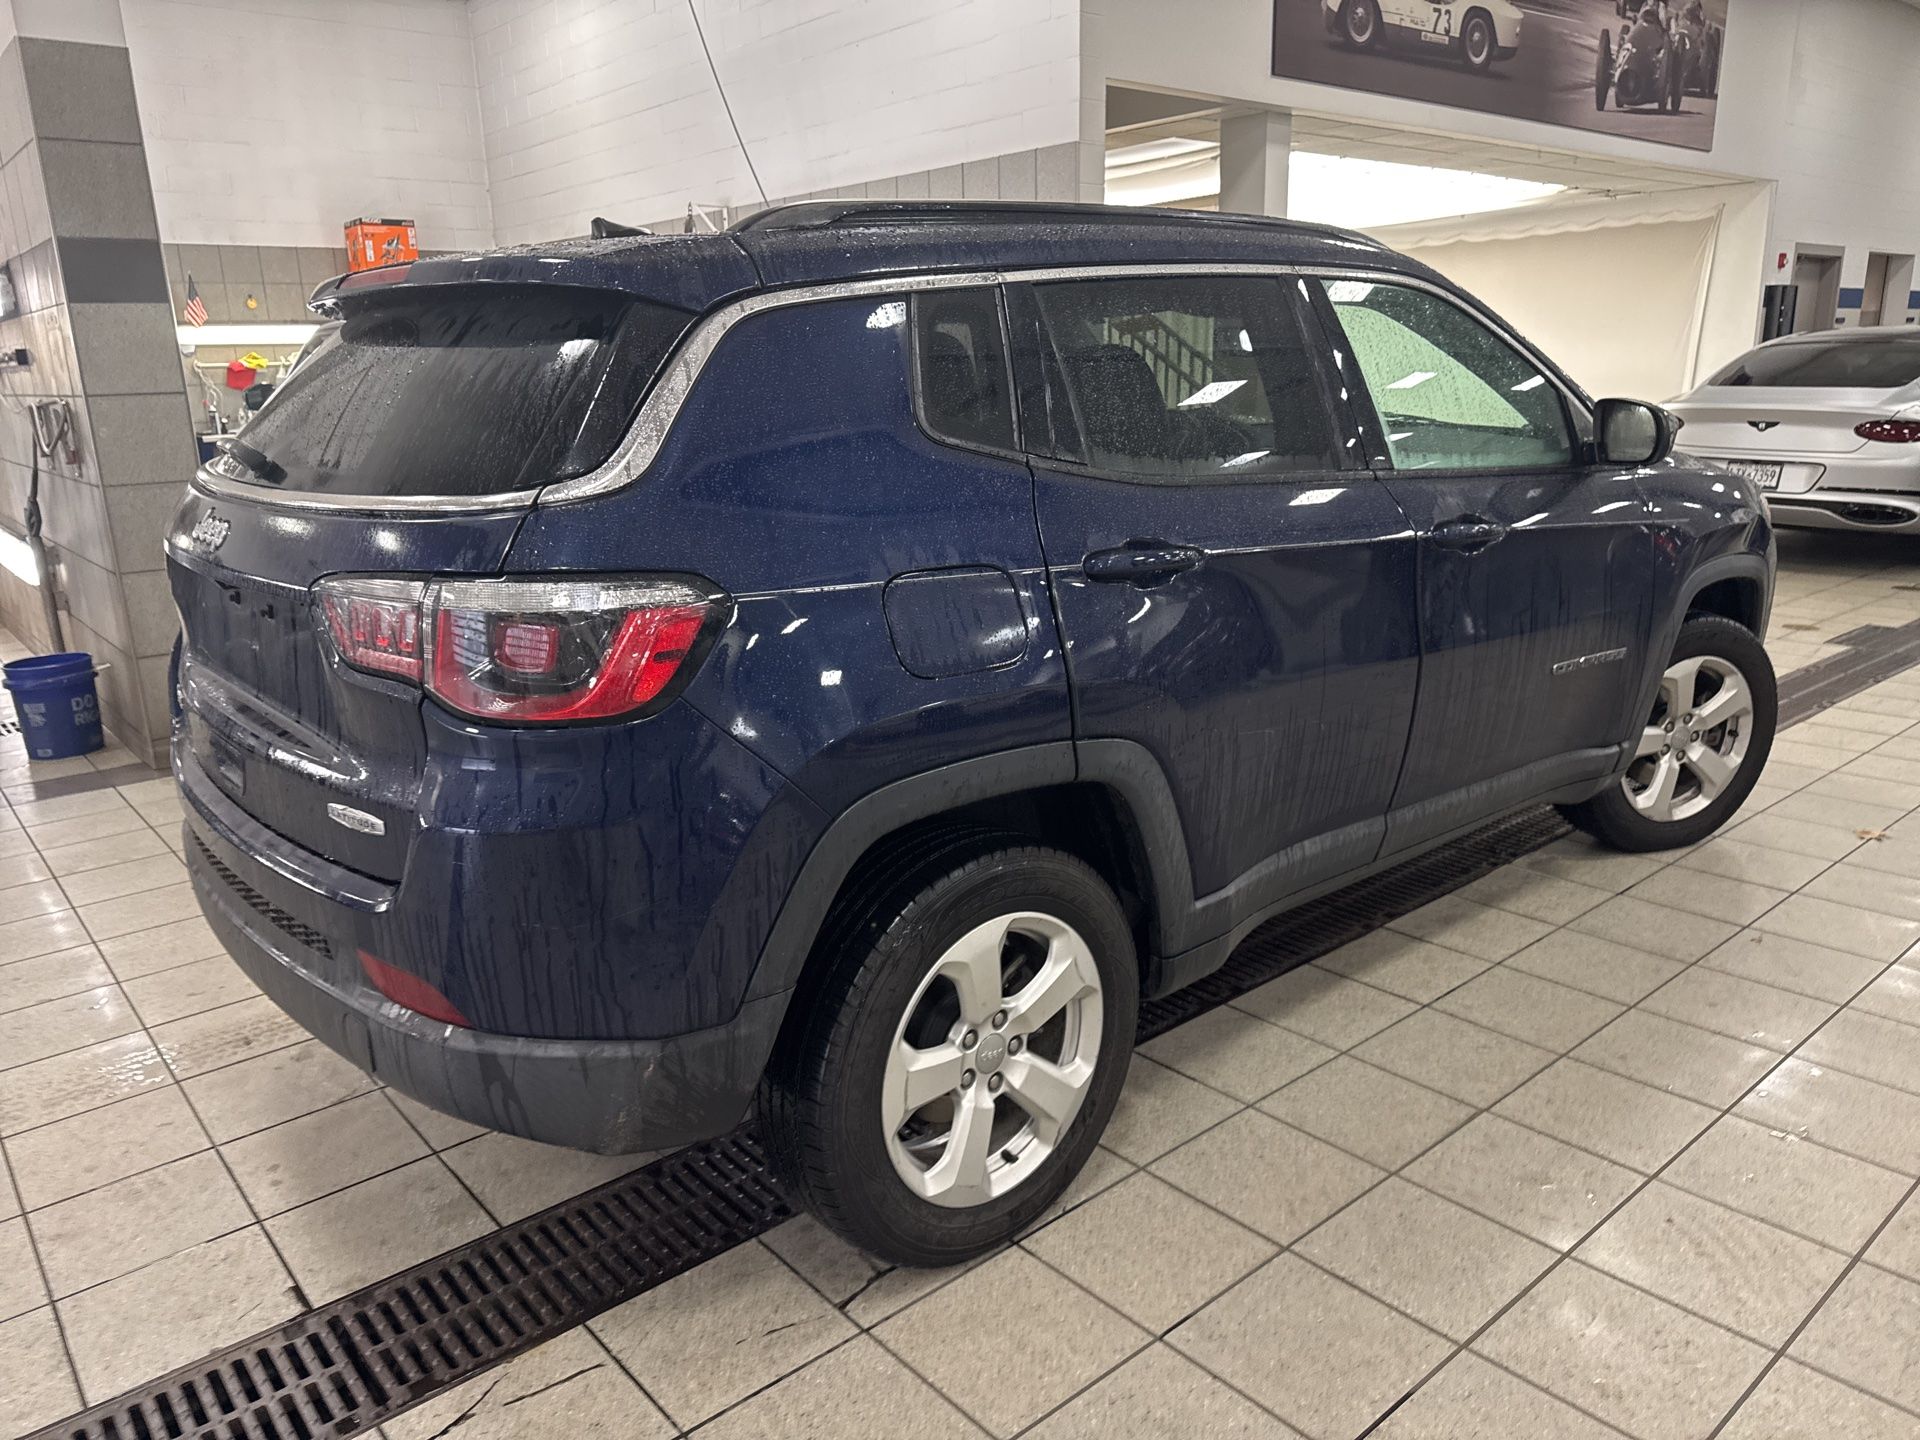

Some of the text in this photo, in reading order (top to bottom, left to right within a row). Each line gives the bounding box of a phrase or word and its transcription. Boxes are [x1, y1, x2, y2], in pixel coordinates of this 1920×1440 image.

[1432, 7, 1451, 36] 73
[192, 508, 229, 552] Jeep
[330, 806, 378, 831] LATITUDE
